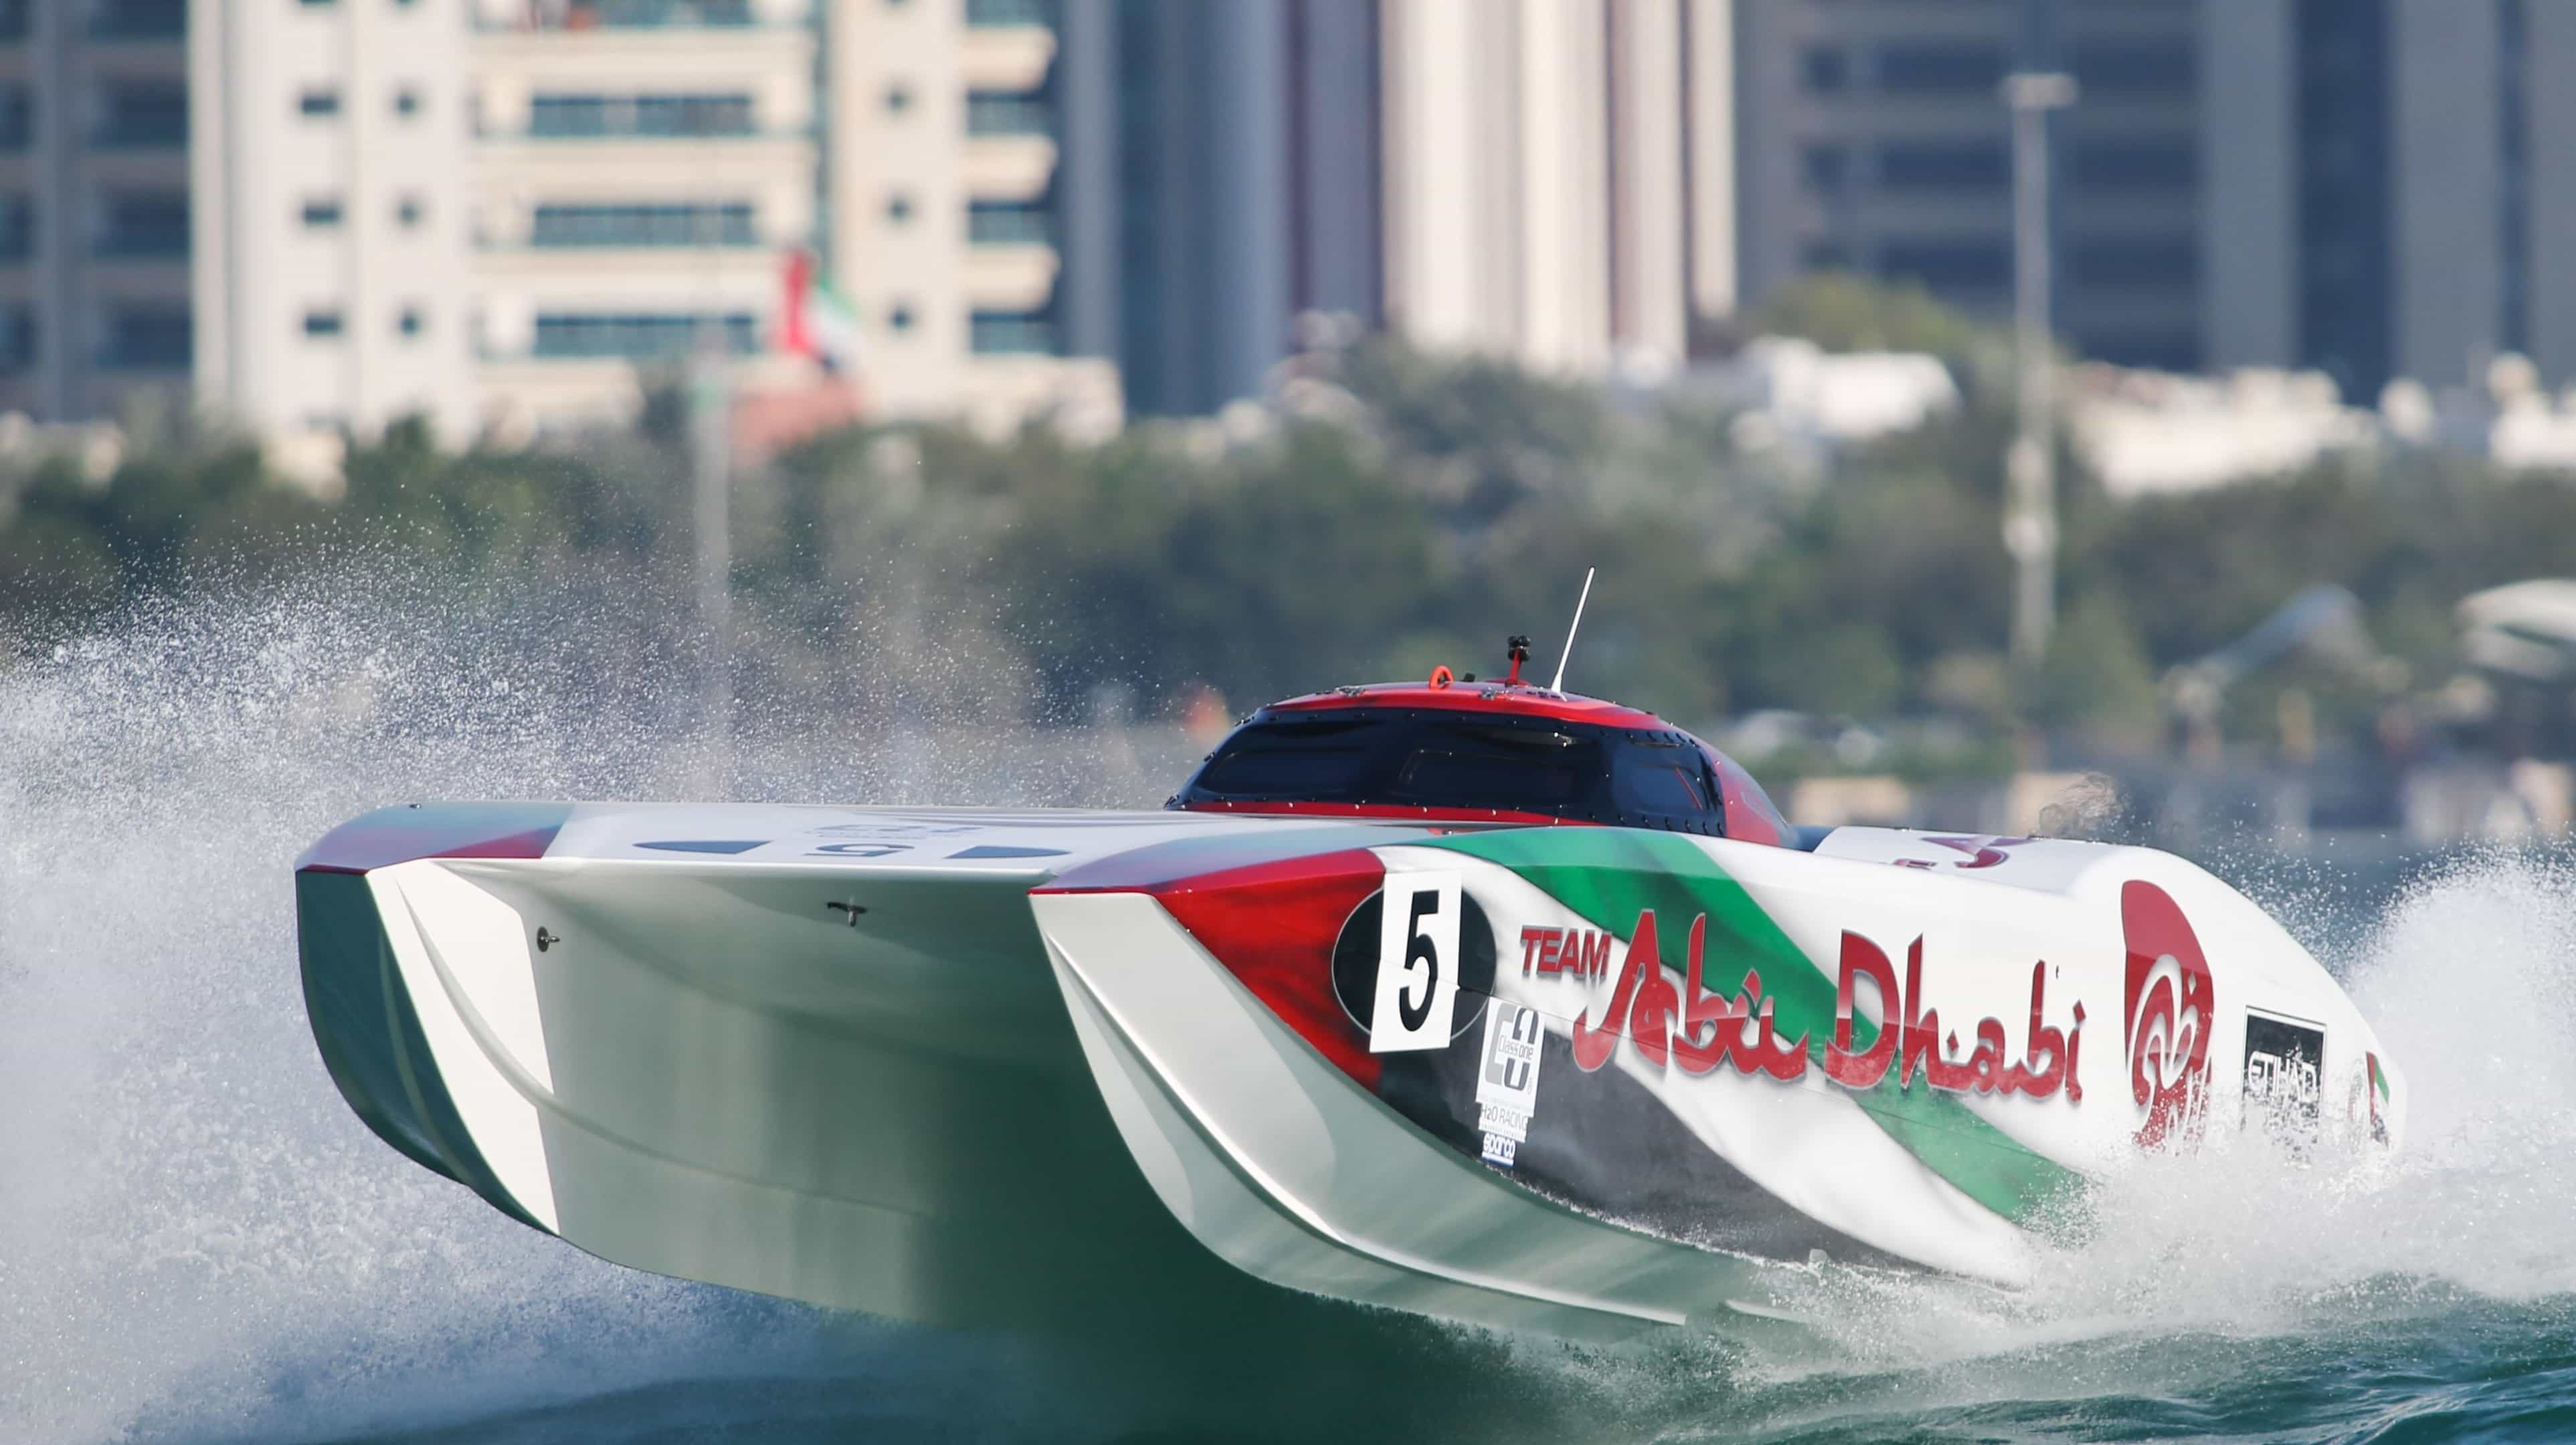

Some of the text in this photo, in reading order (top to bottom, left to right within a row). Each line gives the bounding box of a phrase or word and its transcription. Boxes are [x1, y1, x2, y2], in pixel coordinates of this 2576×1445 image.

[1399, 889, 1439, 1032] 5
[1520, 925, 1613, 977] TEAM
[1571, 908, 2087, 1104] Abu Dhabi
[2248, 1050, 2318, 1105] ETIHAD
[1483, 1133, 1516, 1159] sparco
